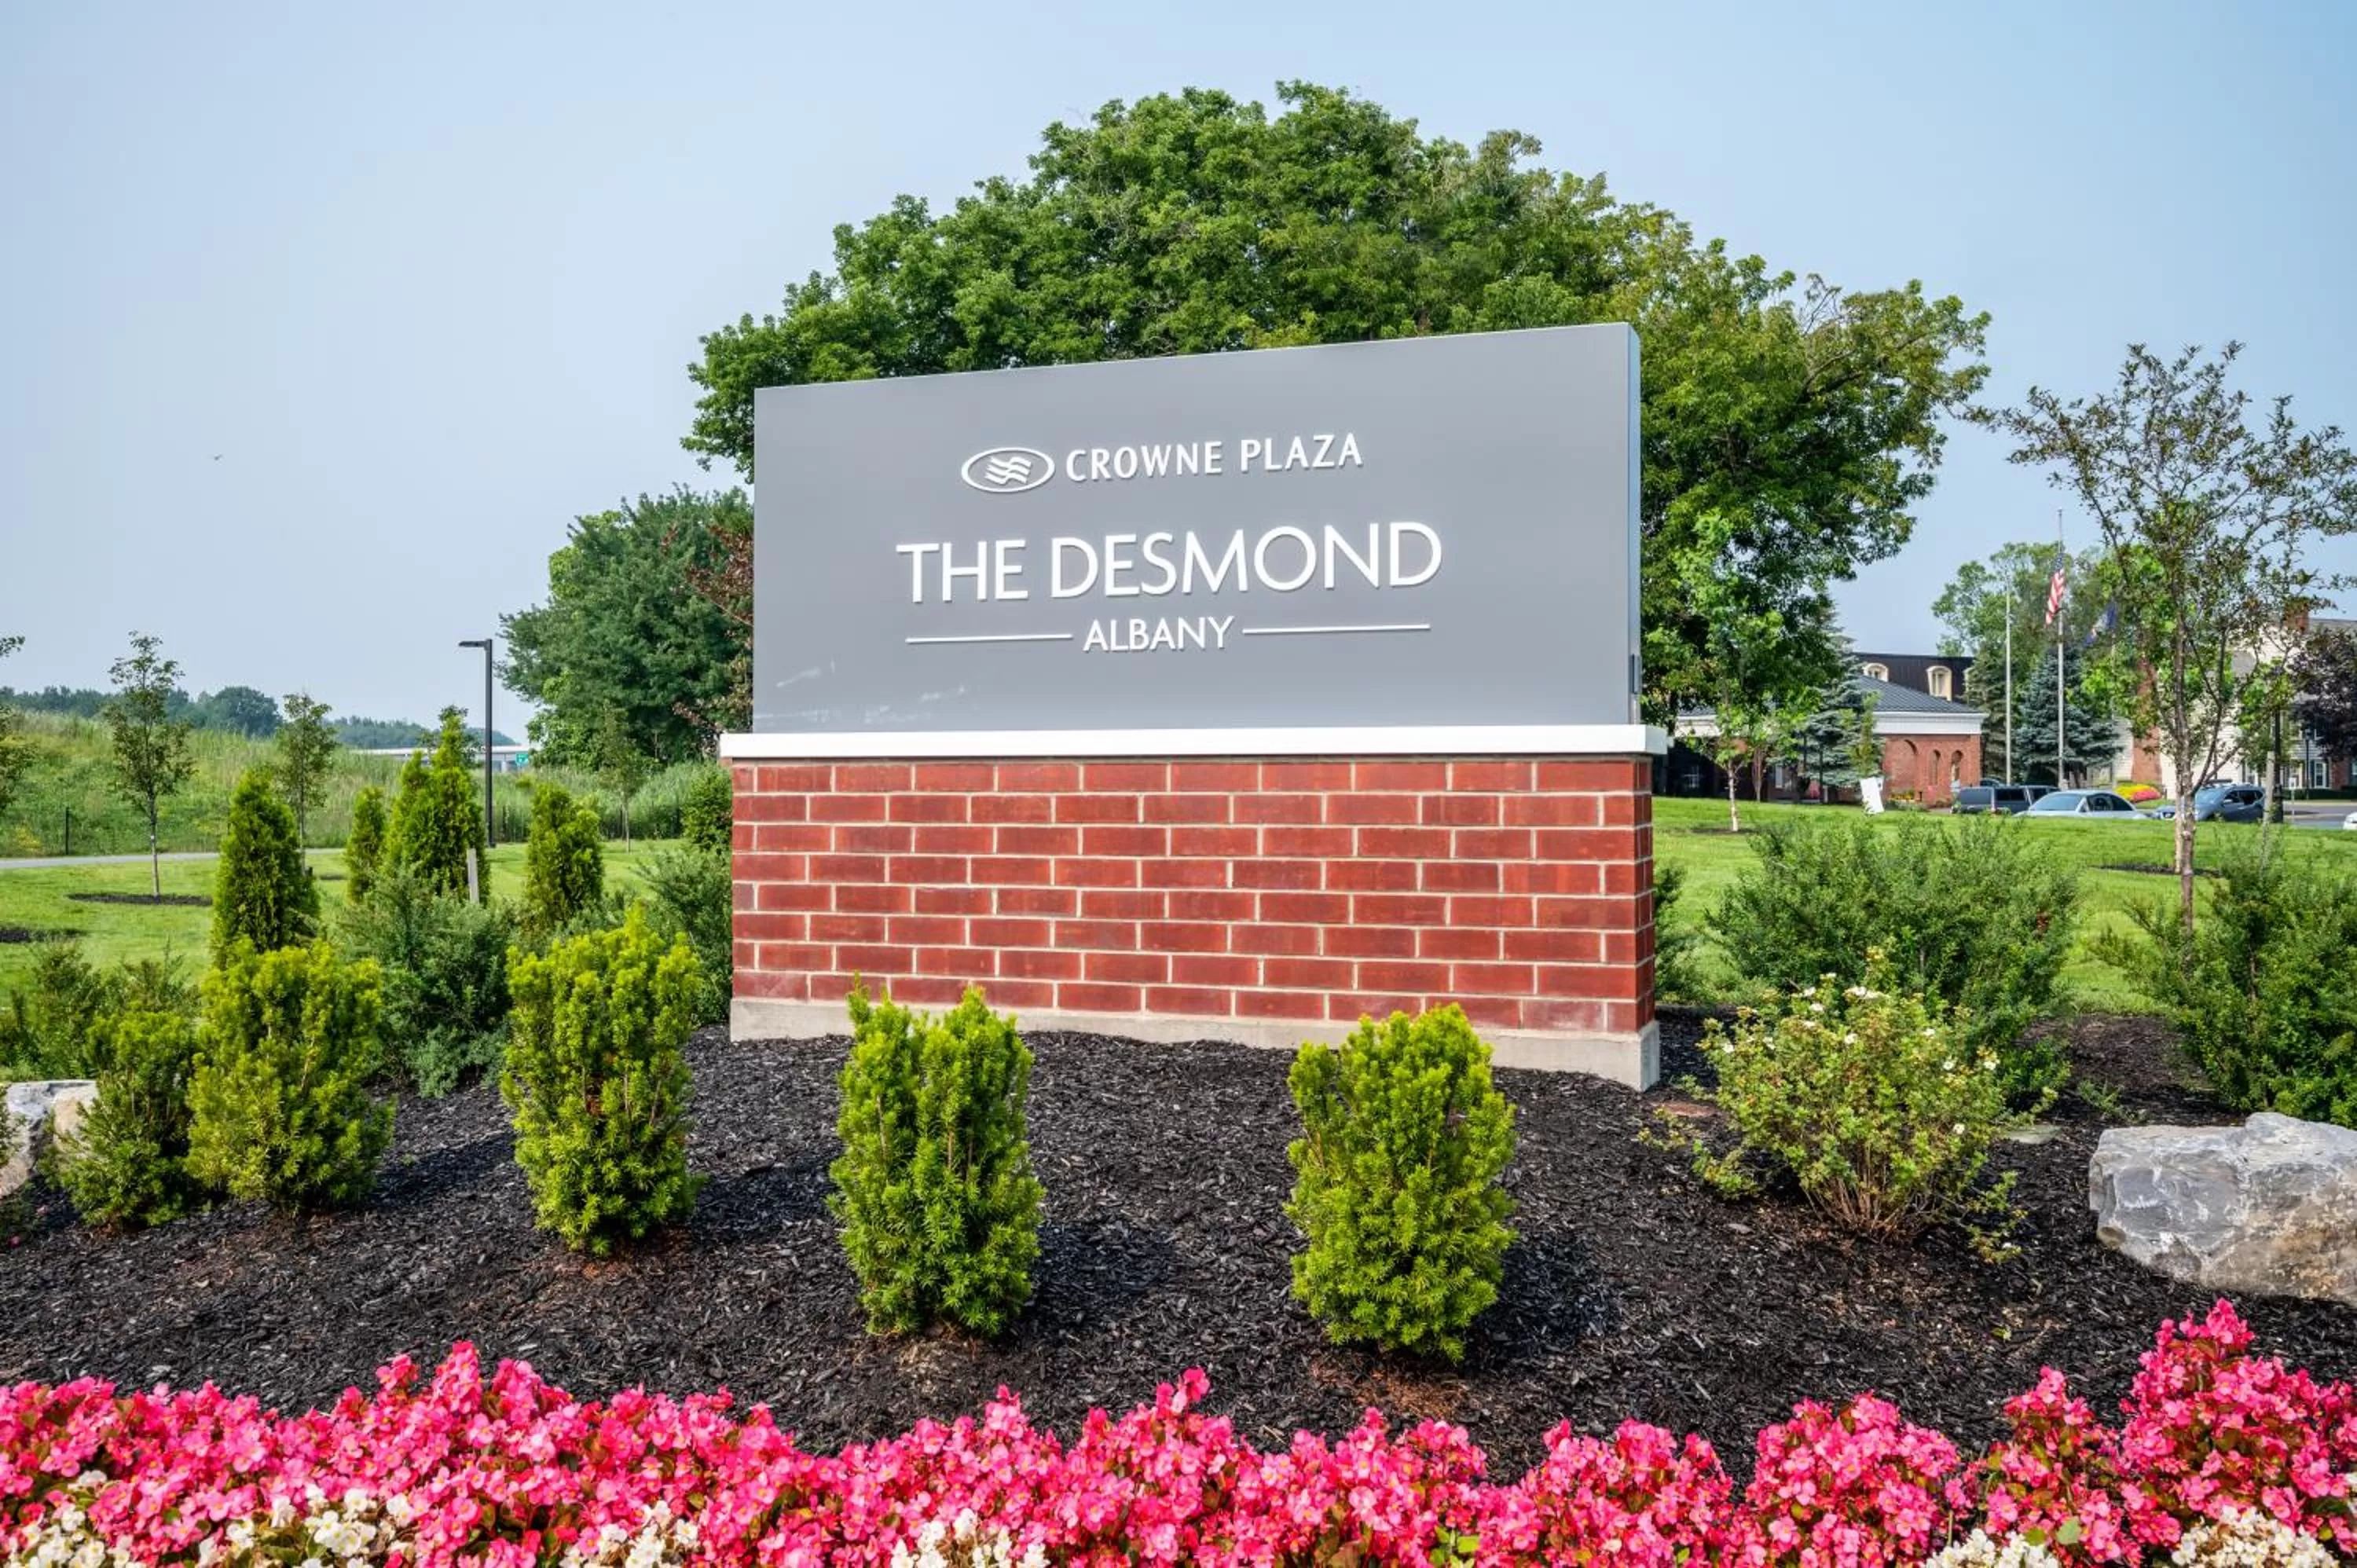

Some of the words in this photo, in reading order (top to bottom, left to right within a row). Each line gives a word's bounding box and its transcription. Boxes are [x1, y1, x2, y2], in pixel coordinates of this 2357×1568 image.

[1065, 440, 1222, 482] CROWNE
[1240, 431, 1363, 472] PLAZA
[895, 538, 1028, 603] THE
[1050, 521, 1442, 599] DESMOND
[1082, 616, 1234, 652] ALBANY
